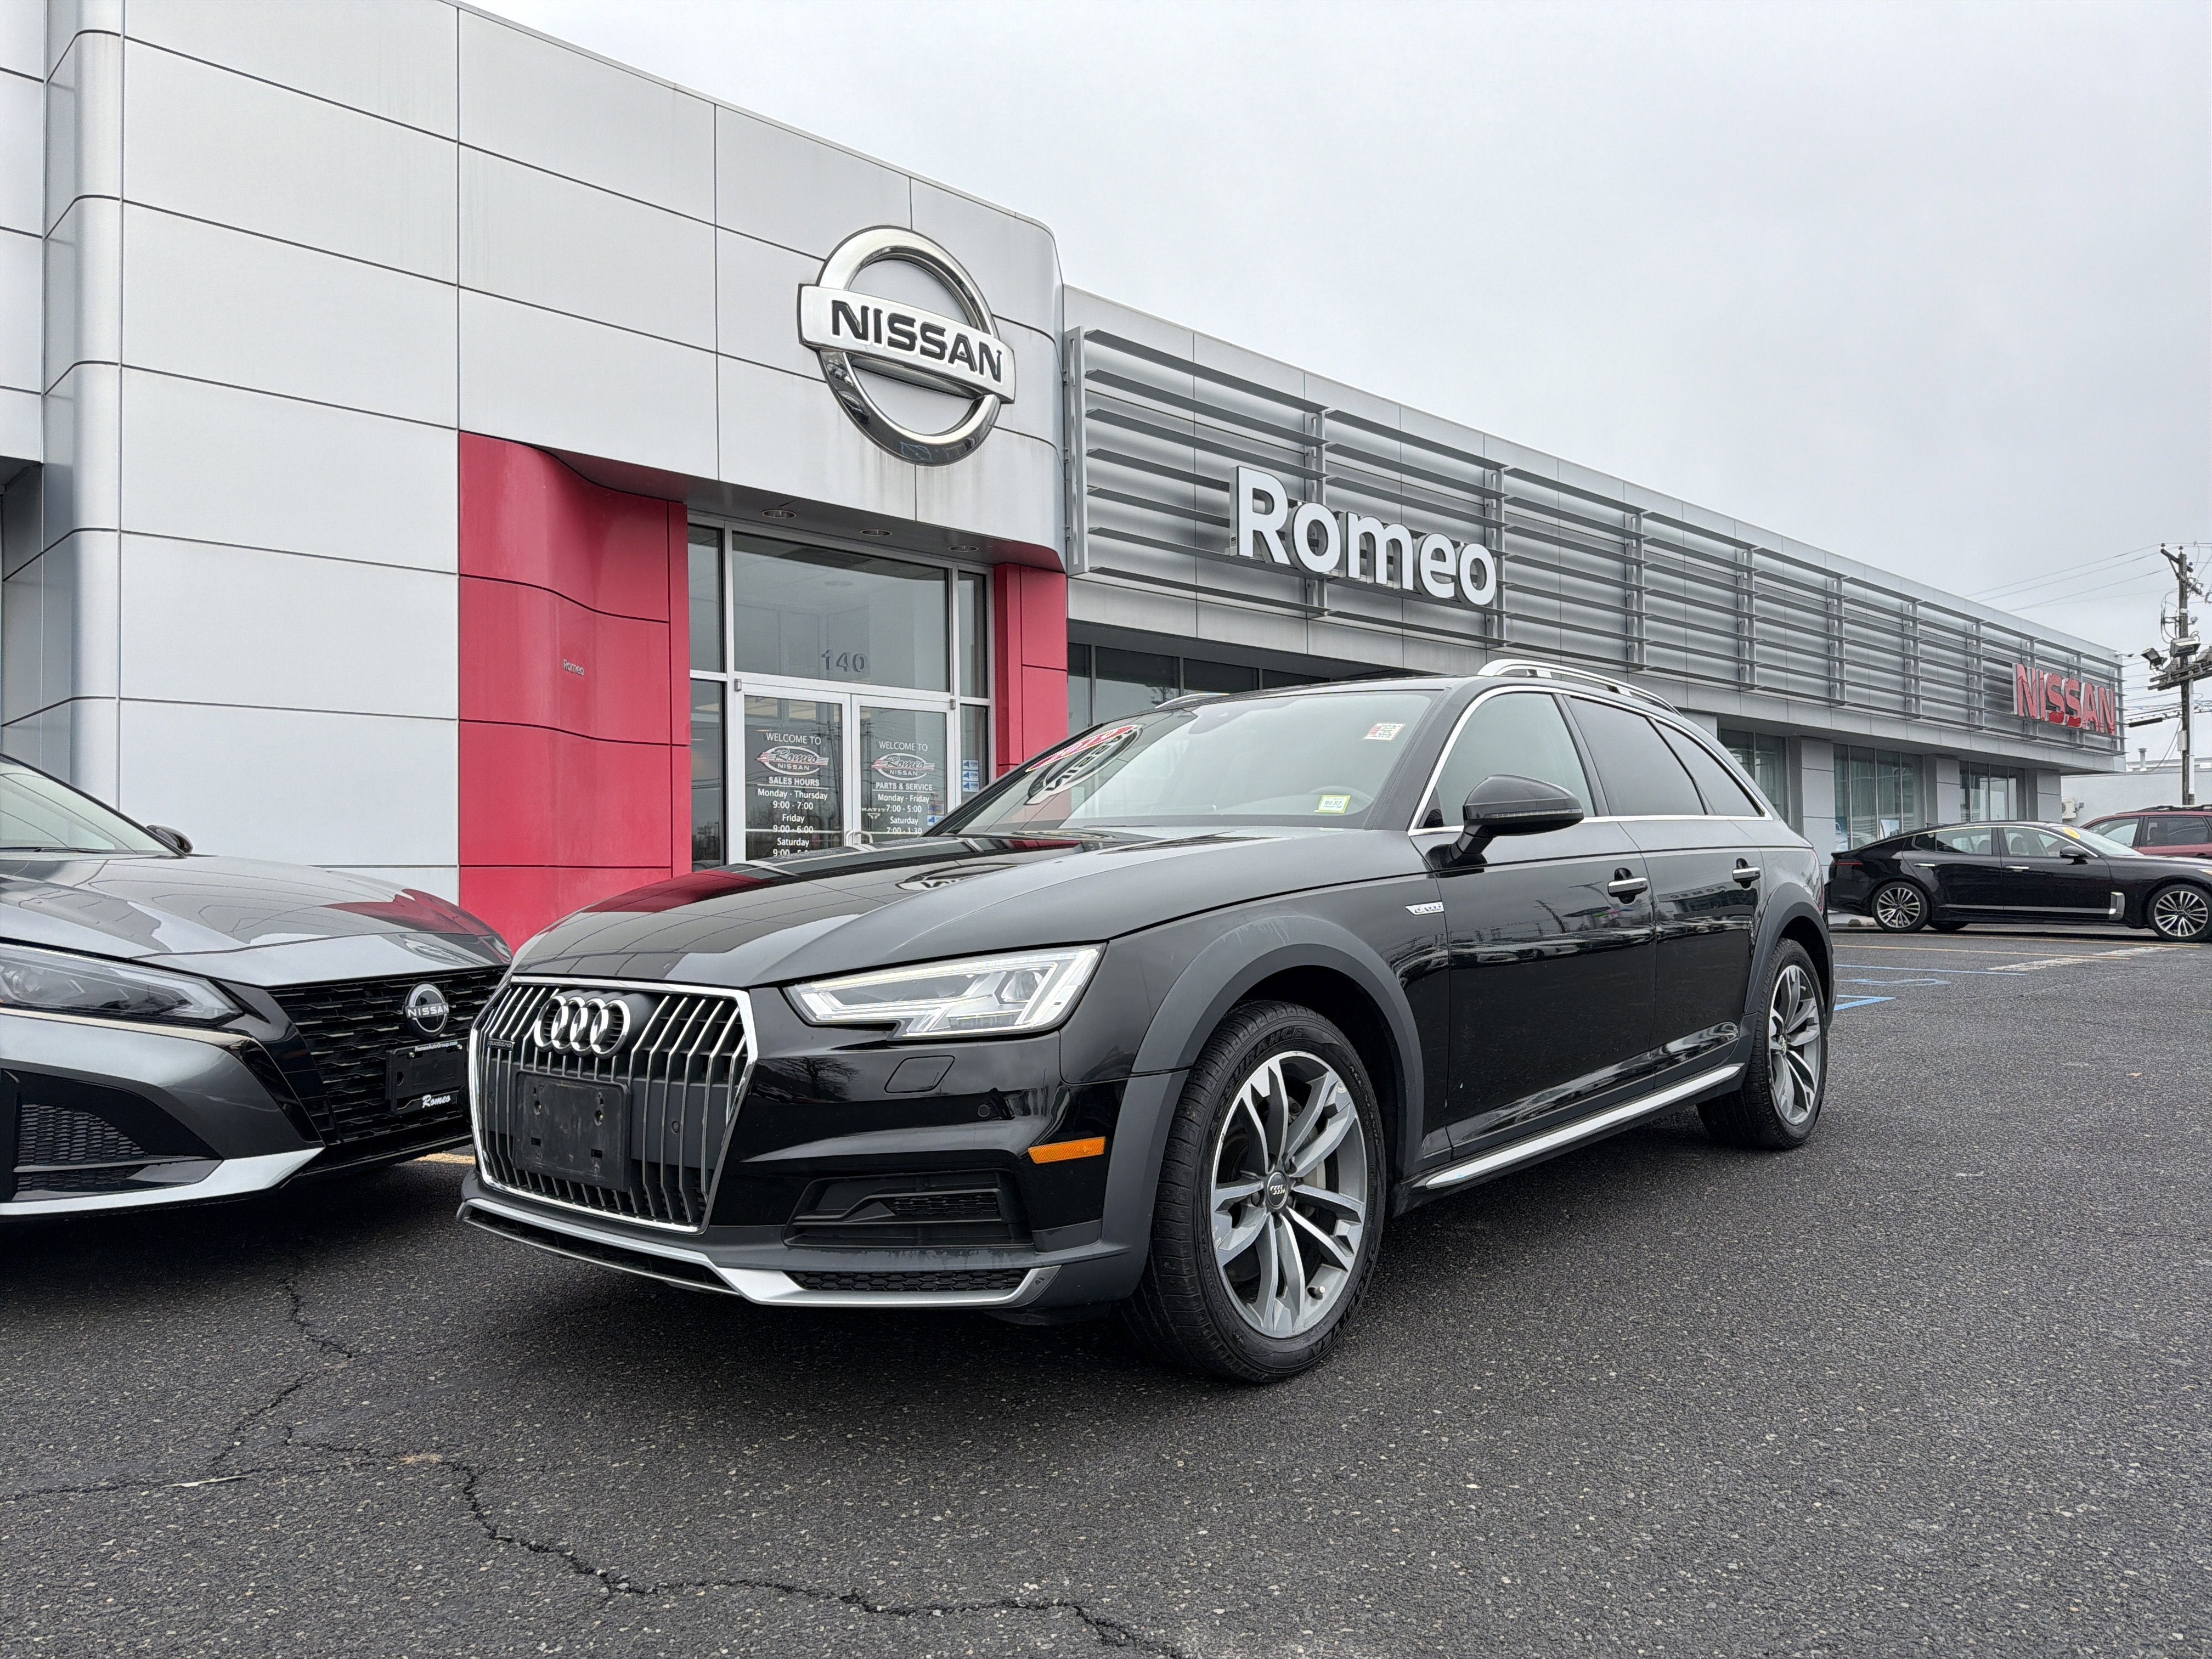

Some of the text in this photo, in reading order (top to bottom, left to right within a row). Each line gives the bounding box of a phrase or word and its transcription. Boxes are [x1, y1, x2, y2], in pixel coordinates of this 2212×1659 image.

[831, 300, 1002, 383] NISSAN
[1234, 465, 1497, 605] Romeo
[563, 658, 584, 676] Romeo
[821, 650, 868, 673] 140
[2016, 663, 2116, 736] NISSAN
[766, 732, 821, 745] WELCOME TO
[878, 741, 928, 752] WELCOME TO
[770, 748, 817, 763] Romeo
[883, 754, 925, 769] Romeo
[769, 776, 820, 787] SALES HOURS
[758, 788, 788, 799] Monday
[794, 790, 828, 801] Thursday
[878, 793, 904, 803] Monday
[910, 795, 930, 804] Friday
[773, 800, 790, 809] 9:00
[797, 802, 814, 810] 7:00
[782, 814, 805, 823] Friday
[890, 816, 919, 826] Saturday
[773, 825, 790, 833] 9:00
[886, 827, 901, 835] 7:00
[907, 827, 922, 835] 1:30
[777, 838, 810, 848] Saturday
[773, 849, 790, 857] 9:00
[408, 1004, 449, 1017] NISSAN
[415, 1041, 458, 1052] RomeoAutoGroup.com
[422, 1094, 451, 1109] Romeo
